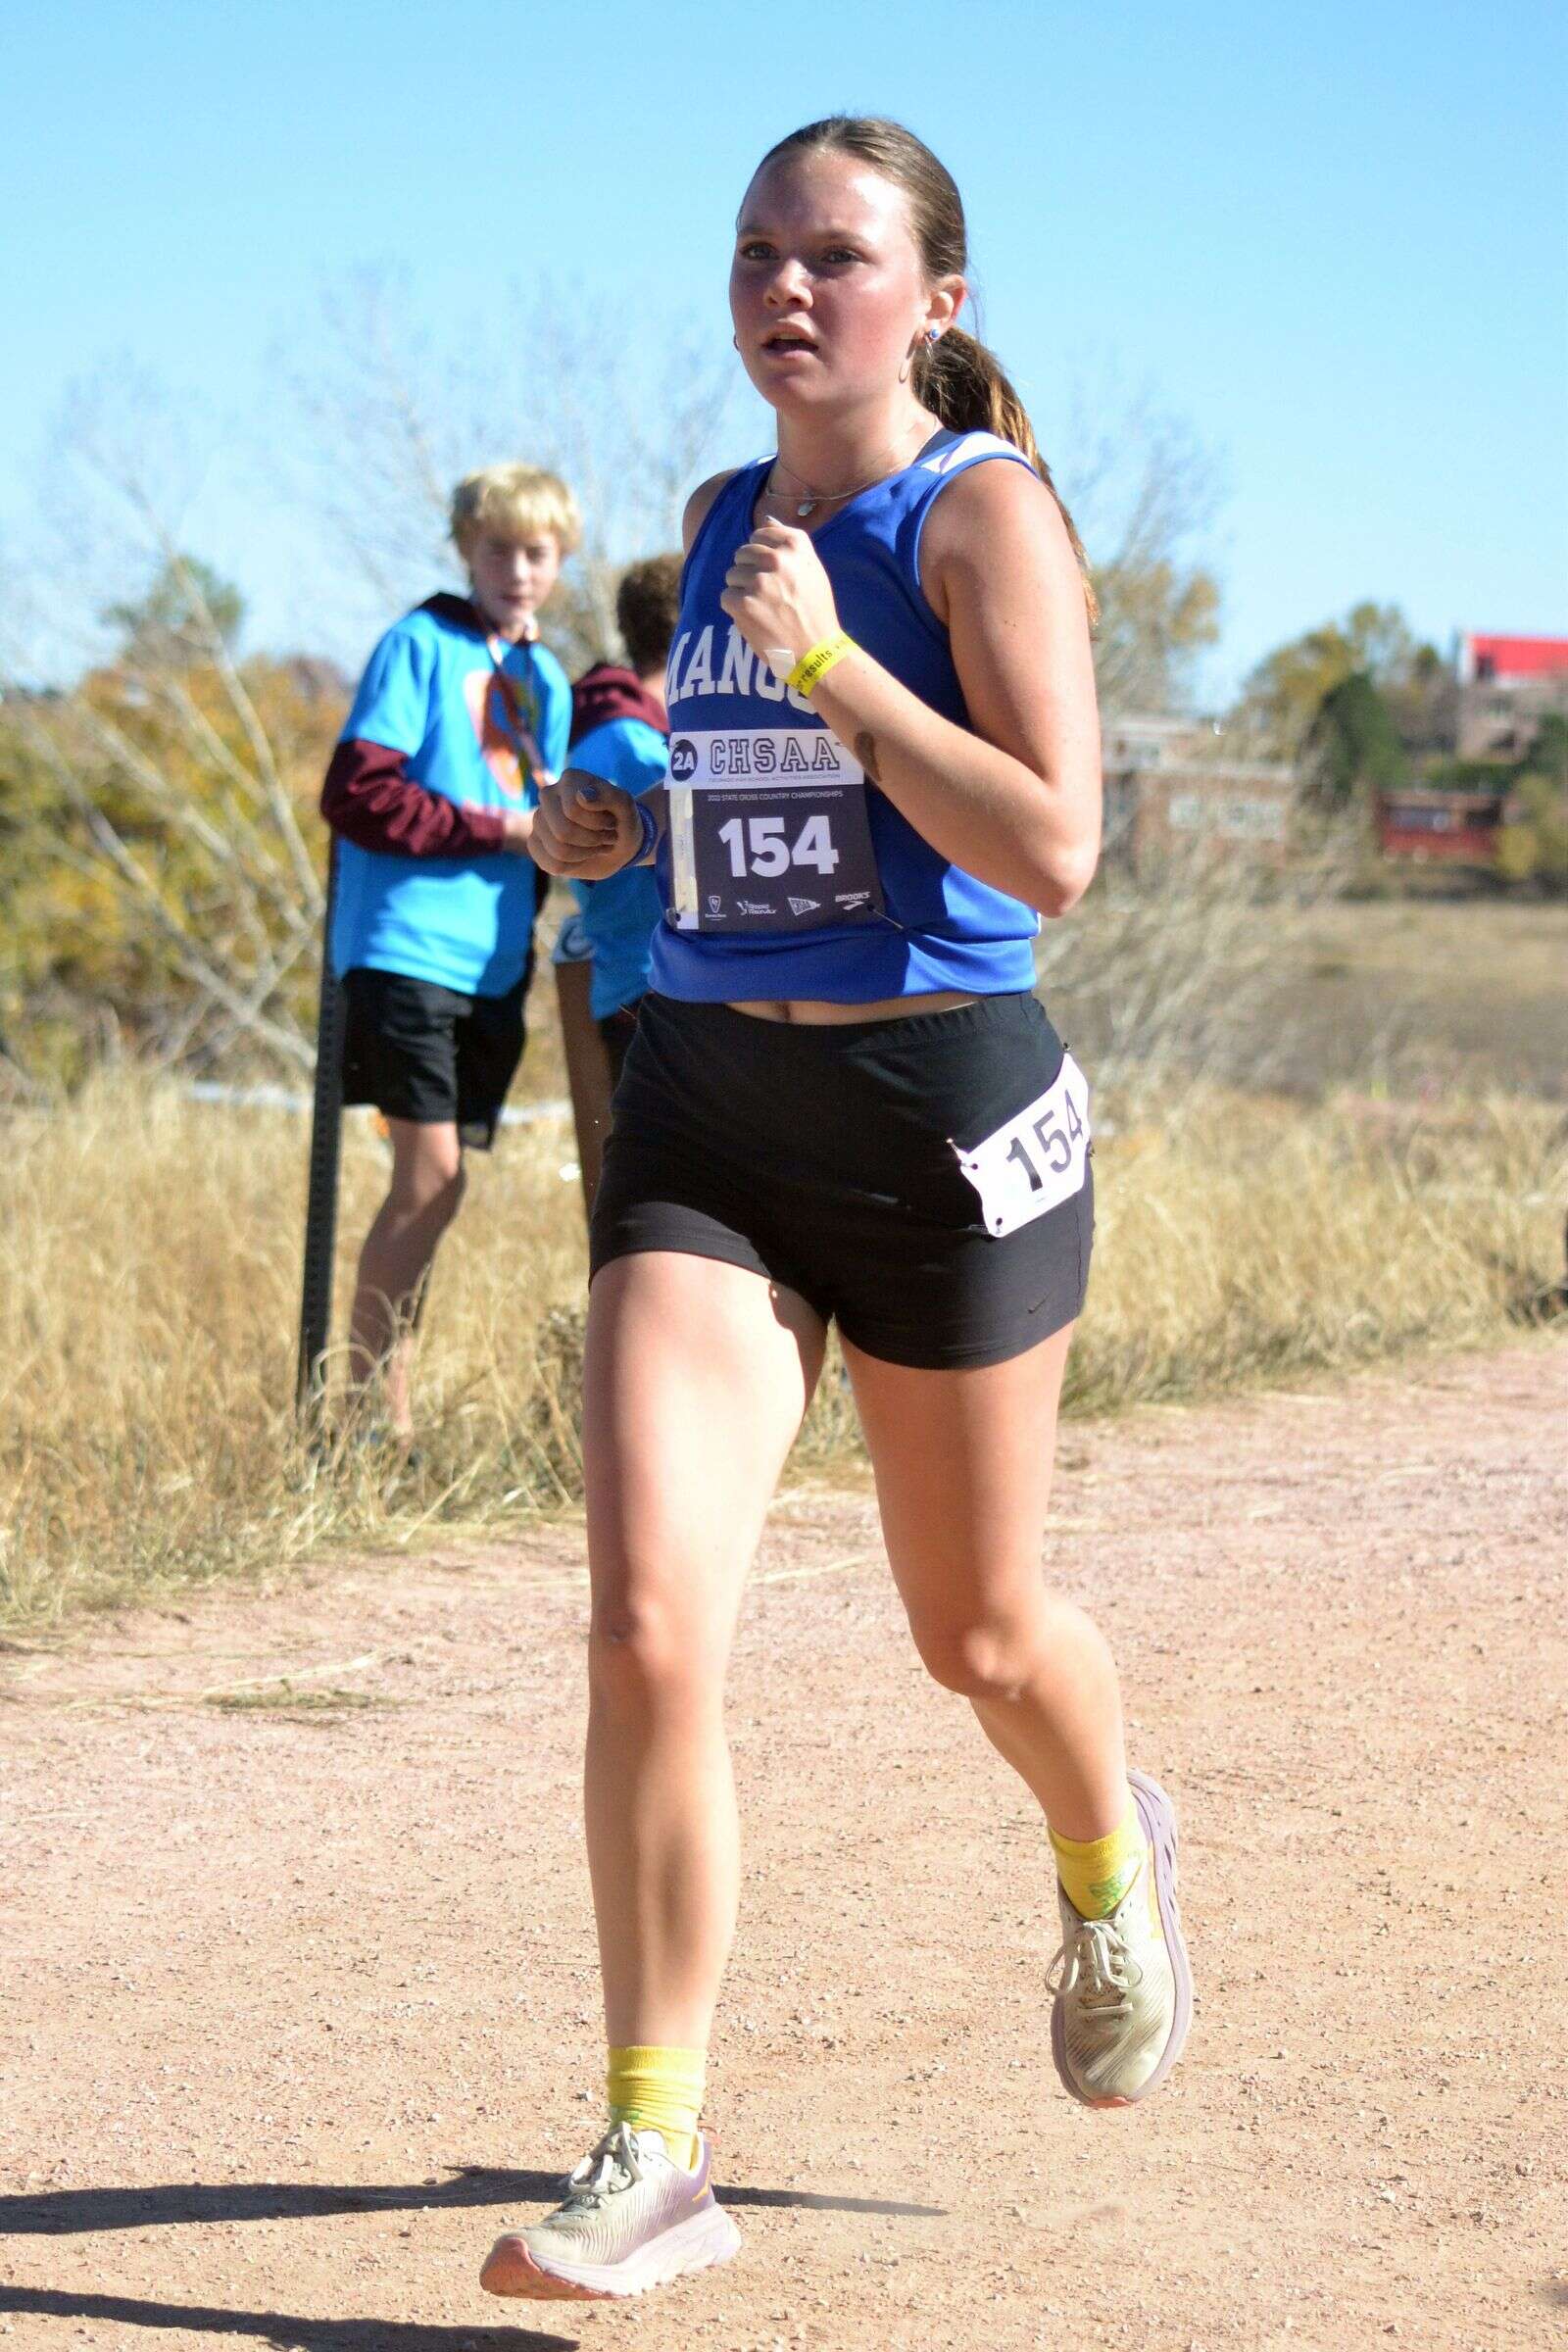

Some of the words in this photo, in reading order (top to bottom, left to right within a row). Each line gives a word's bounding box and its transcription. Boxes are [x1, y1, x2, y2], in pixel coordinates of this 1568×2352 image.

[801, 650, 833, 682] results
[673, 751, 696, 771] 2A
[710, 737, 840, 775] CHSAA
[760, 792, 790, 801] COUNTRY
[791, 790, 844, 799] CHAMPIONSHIPS
[717, 815, 840, 878] 154
[835, 891, 871, 903] BROOKS
[1005, 1089, 1084, 1193] 154
